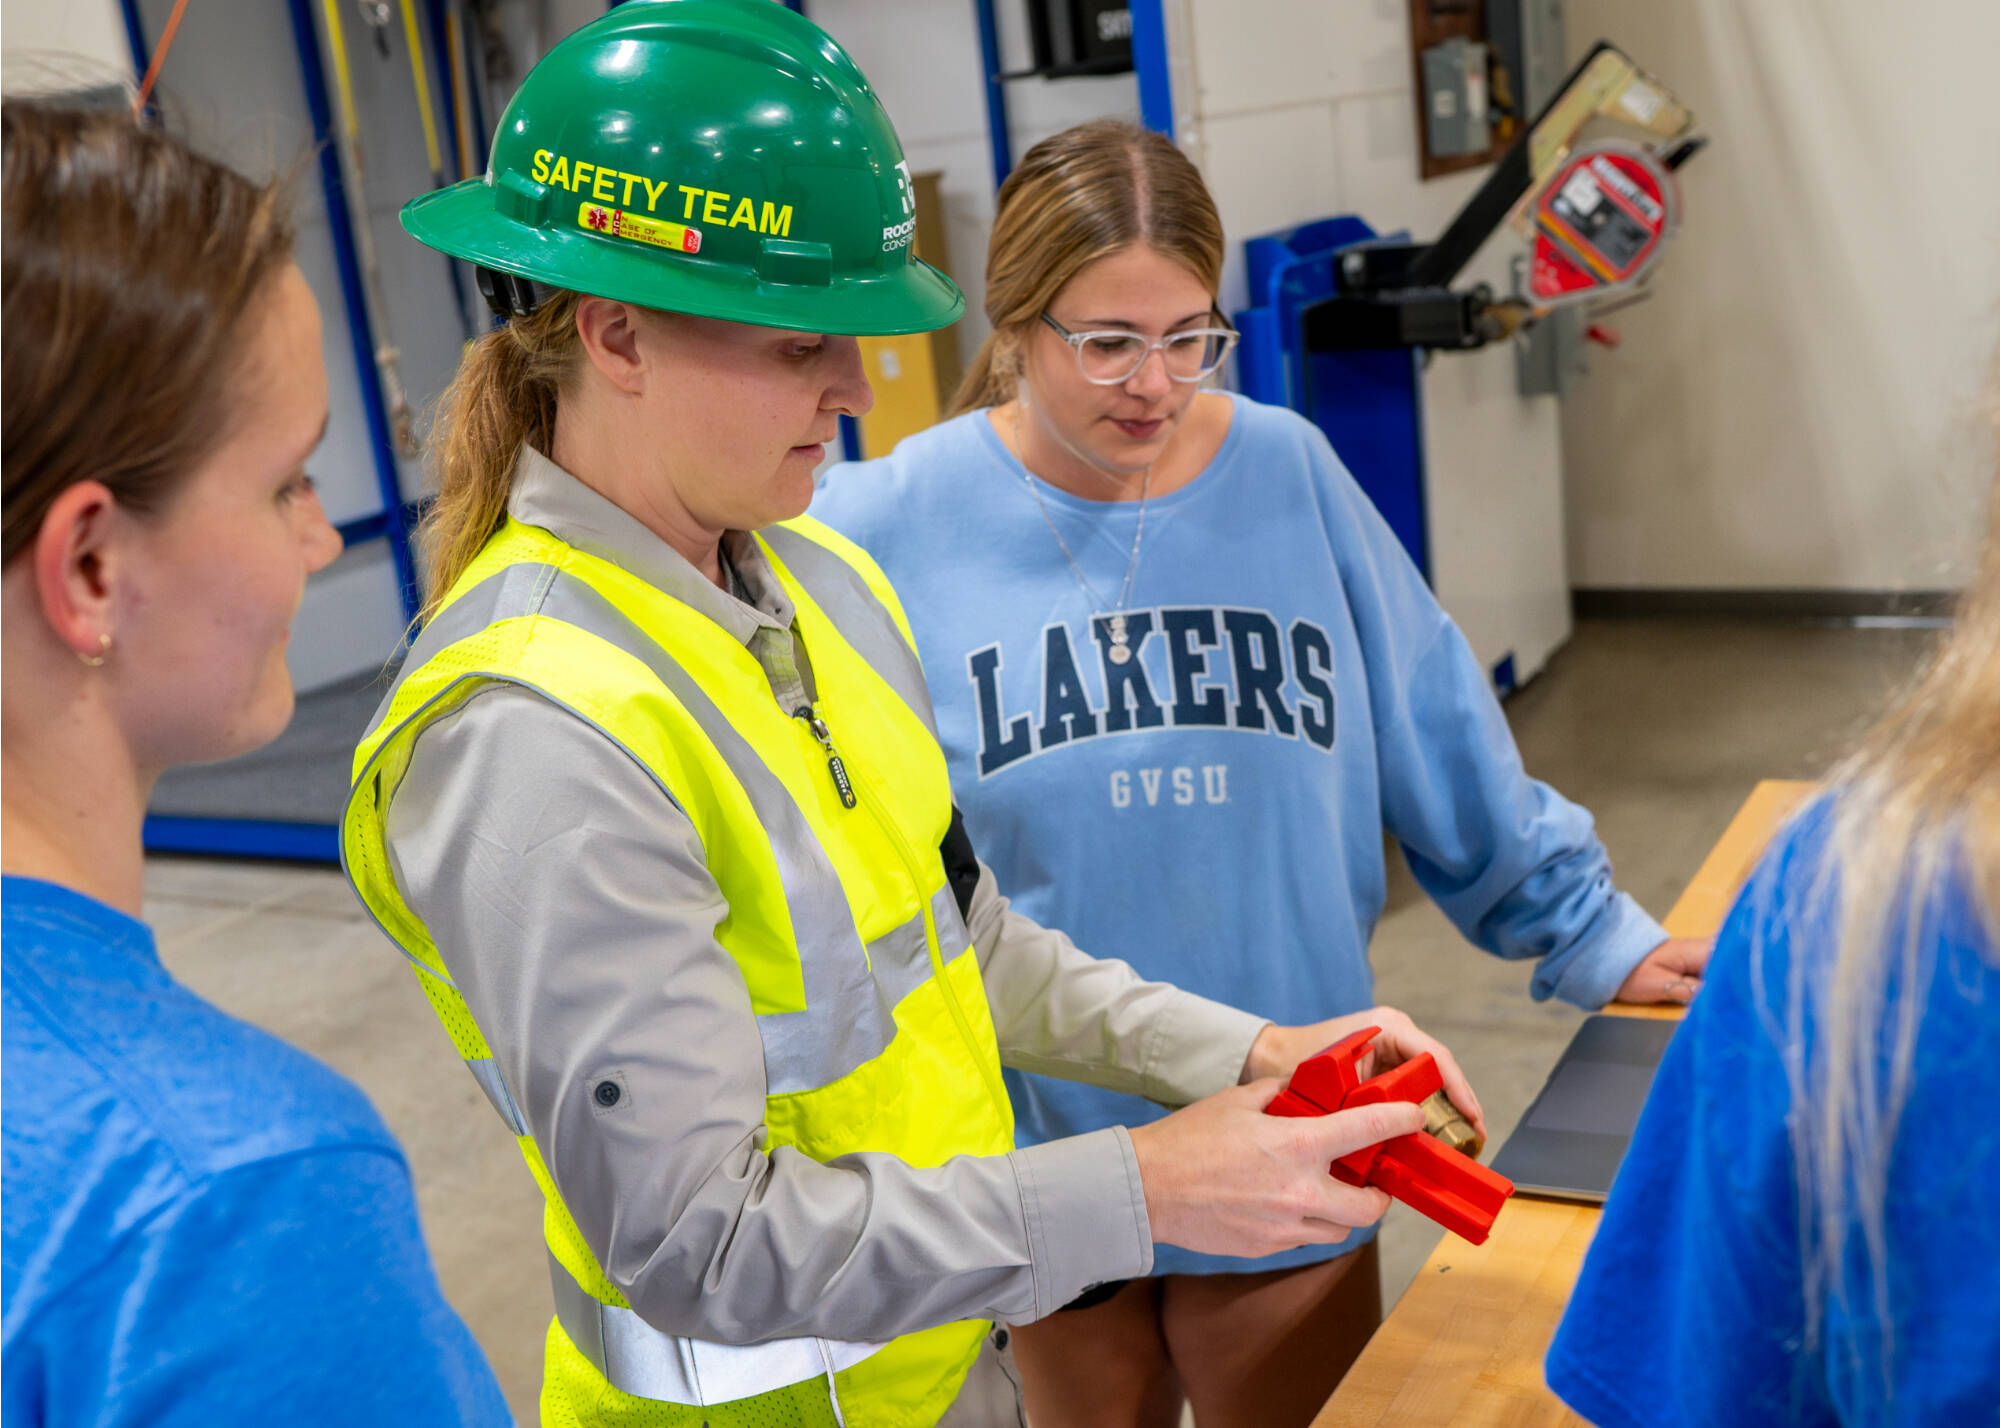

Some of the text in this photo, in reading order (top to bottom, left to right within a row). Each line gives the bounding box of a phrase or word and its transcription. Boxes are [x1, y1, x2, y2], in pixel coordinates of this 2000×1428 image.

[531, 149, 793, 237] SAFETY TEAM
[643, 227, 657, 235] OF
[965, 605, 1336, 781] LAKERS
[1110, 764, 1229, 808] GVSU
